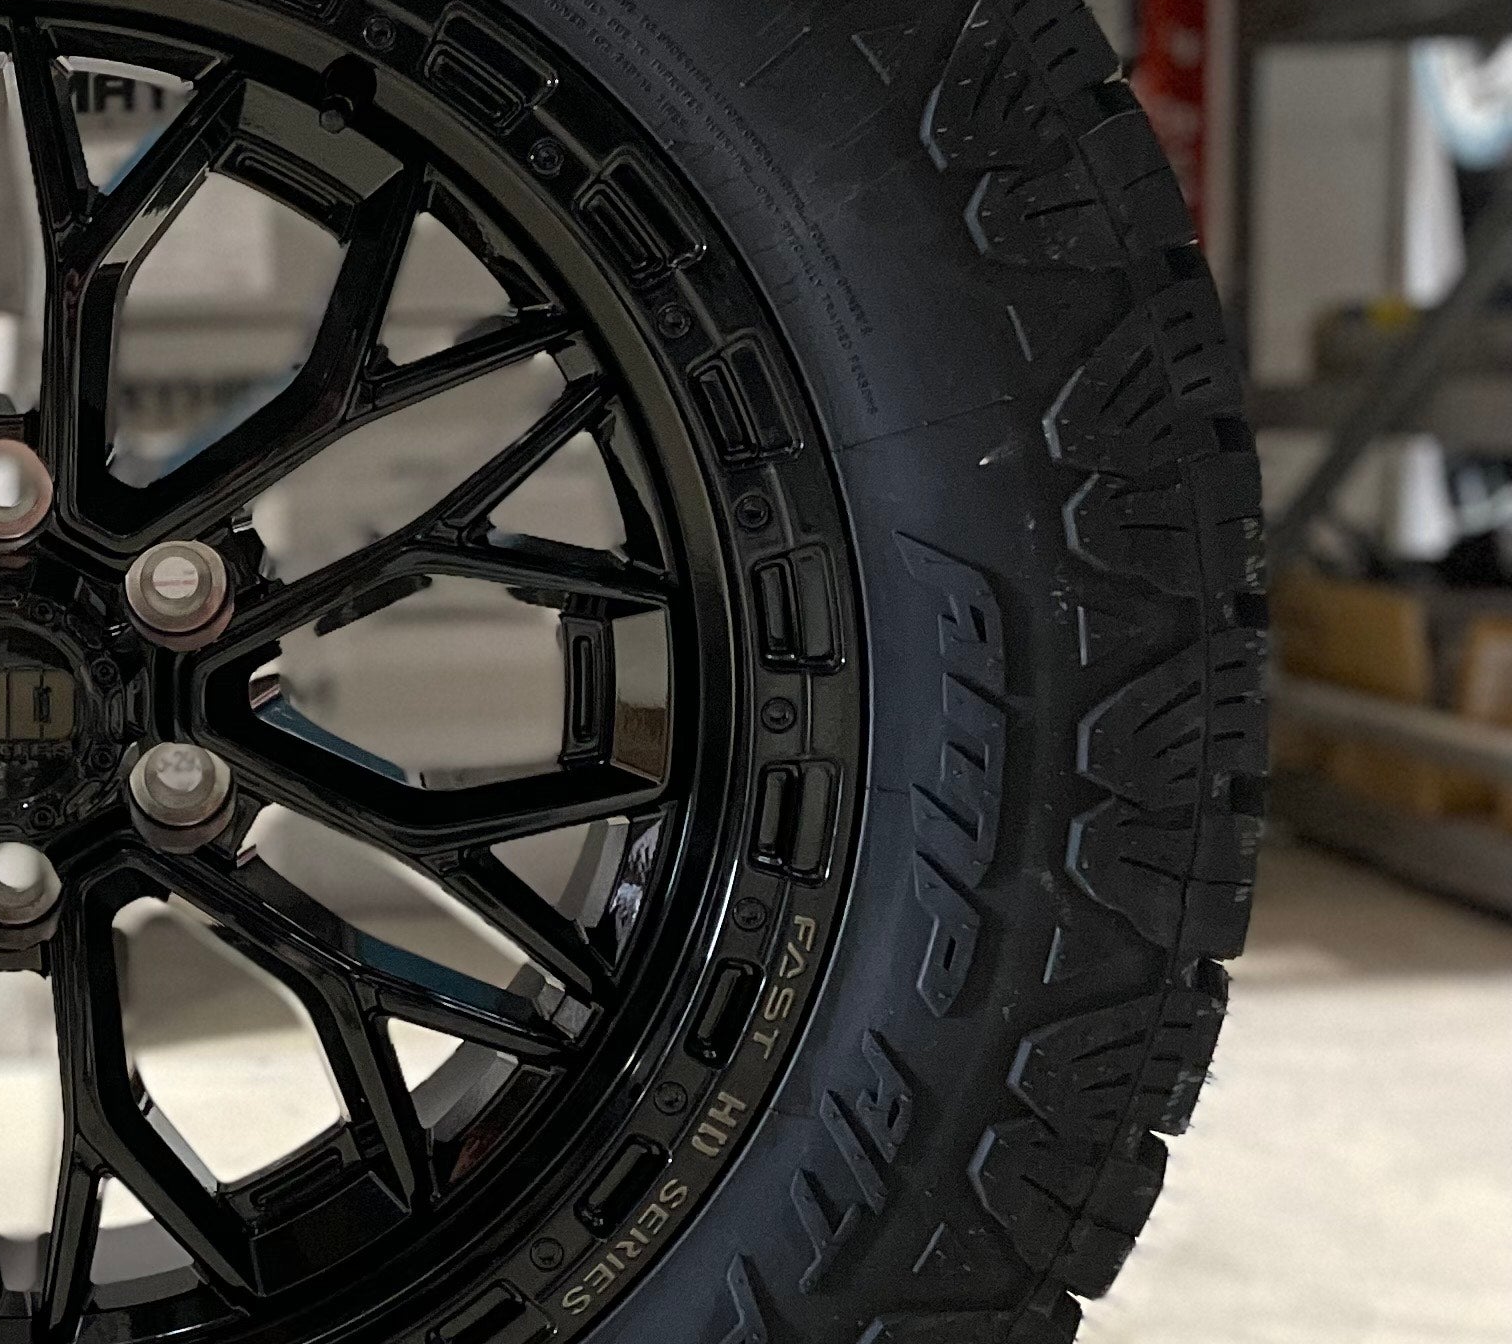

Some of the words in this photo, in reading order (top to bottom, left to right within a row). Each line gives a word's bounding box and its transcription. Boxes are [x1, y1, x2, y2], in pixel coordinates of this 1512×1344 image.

[753, 915, 817, 1060] FAST
[691, 1091, 747, 1157] HD
[562, 1179, 689, 1316] SERIES
